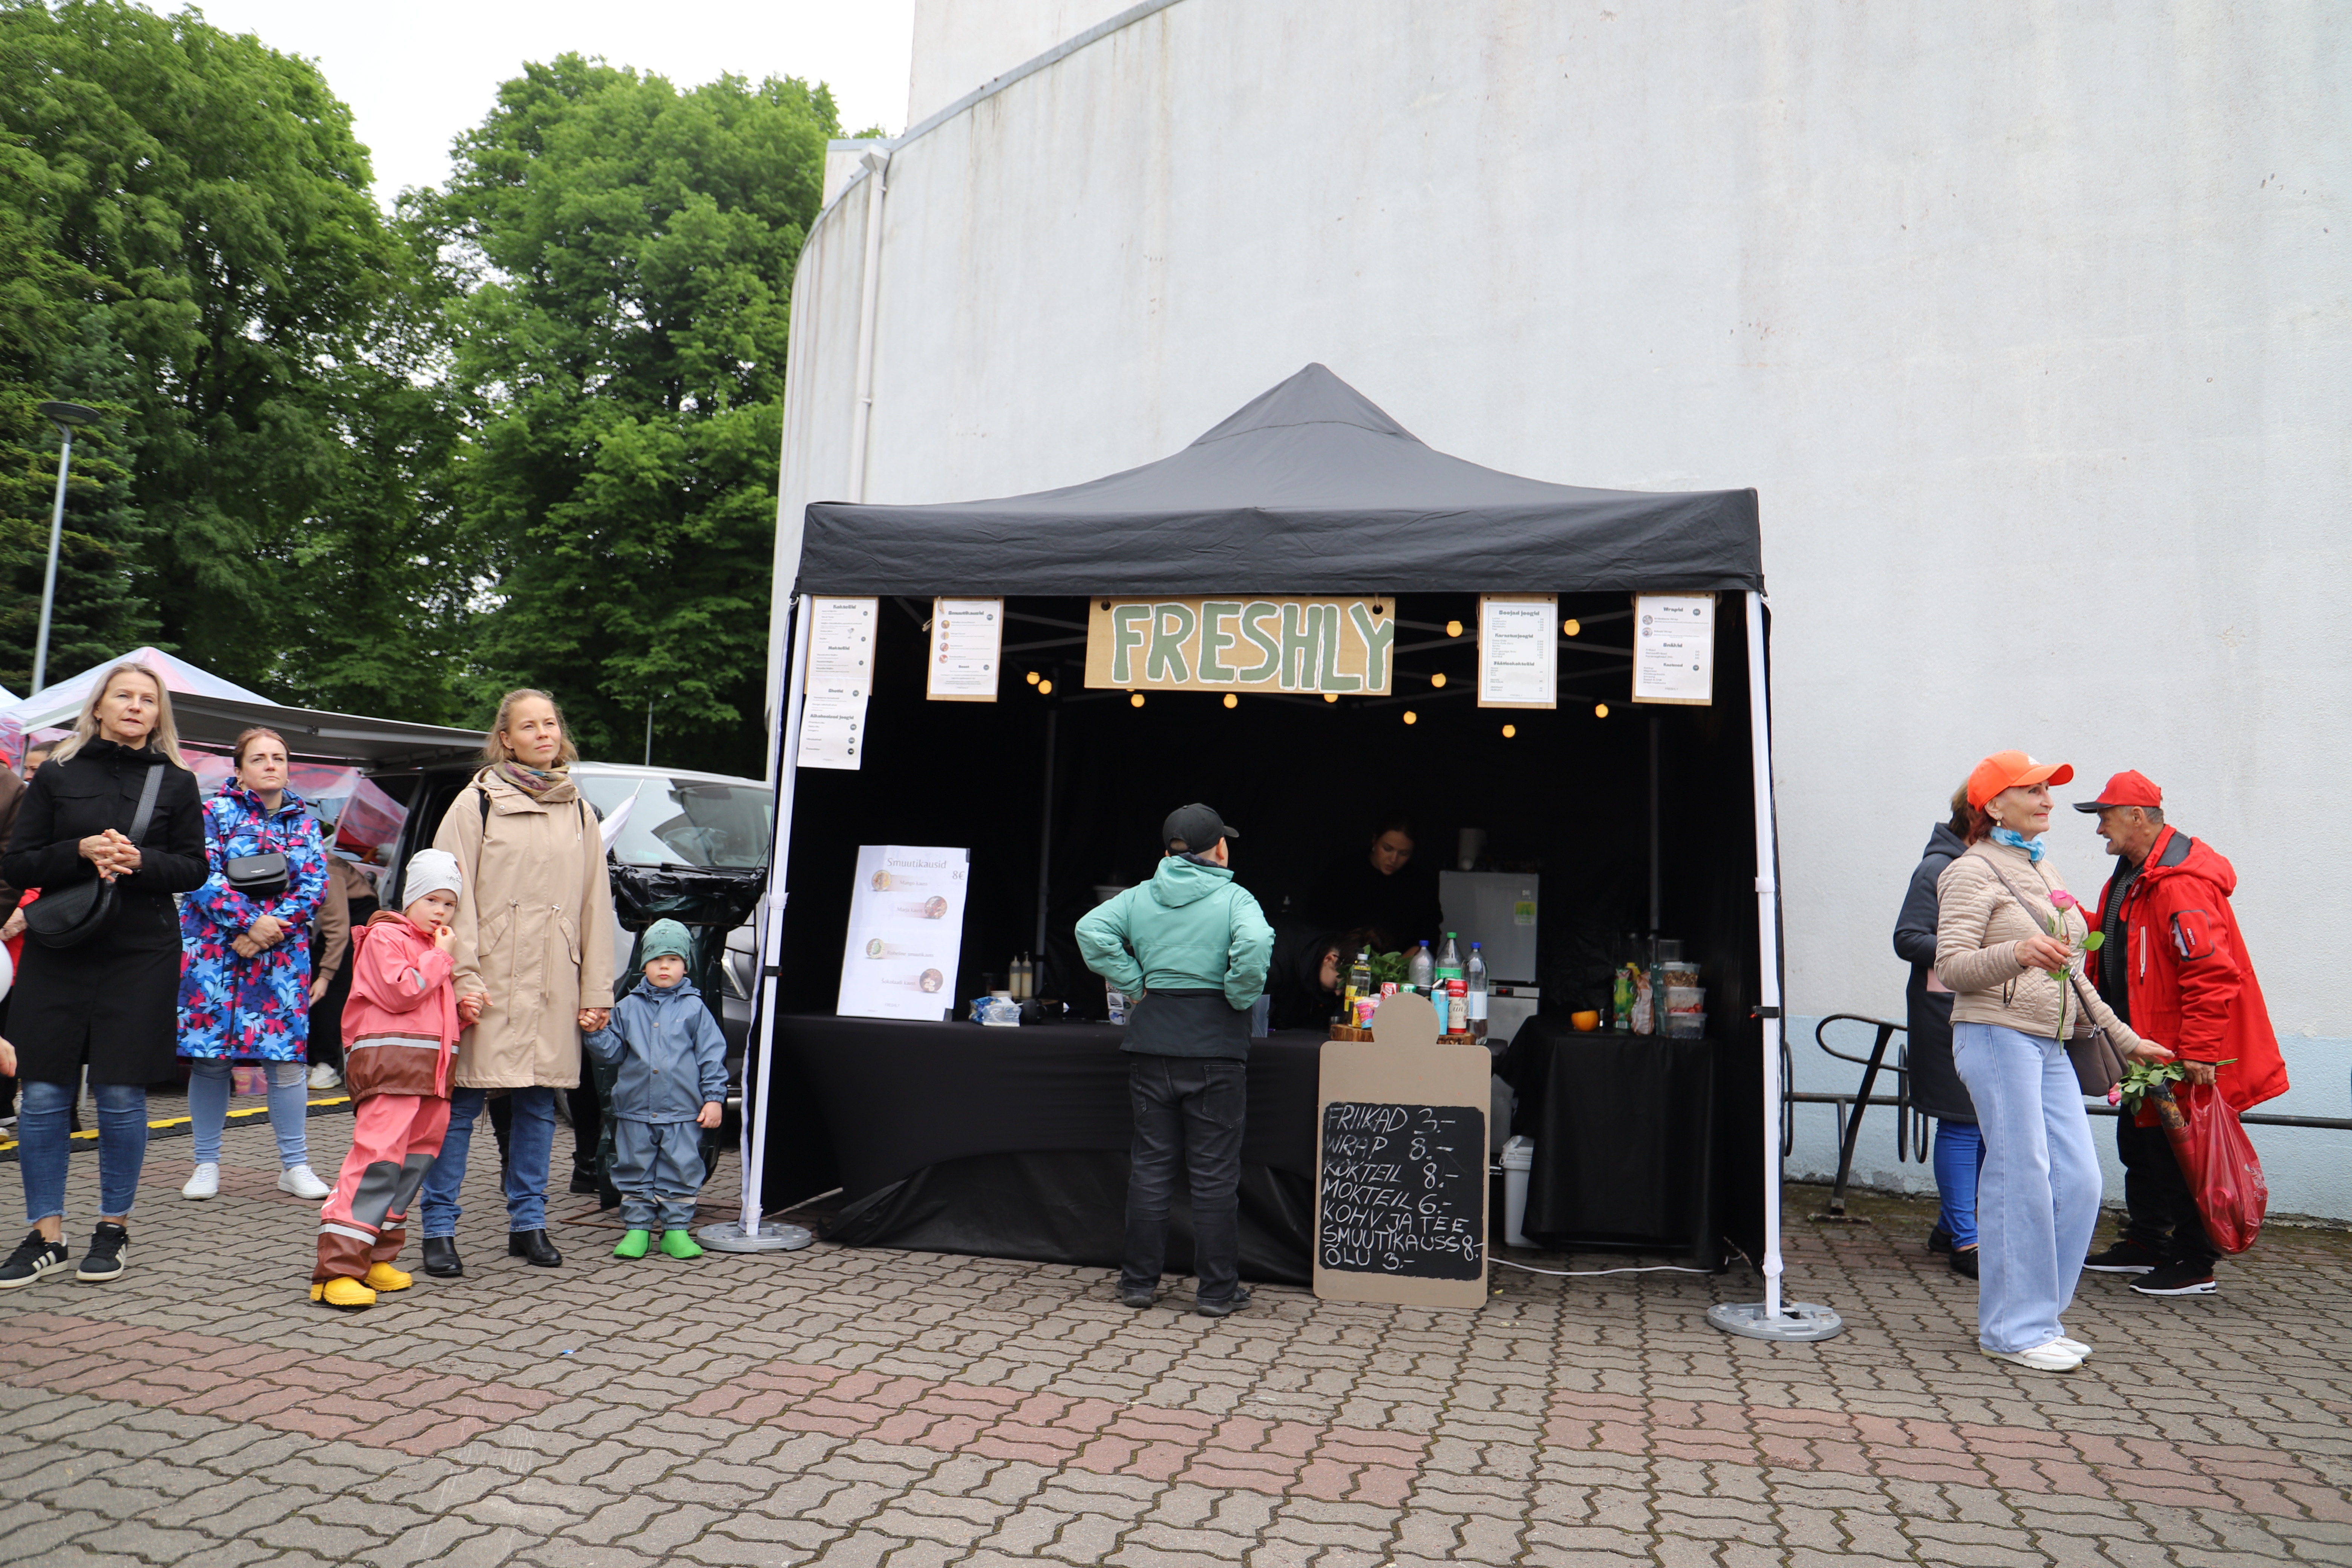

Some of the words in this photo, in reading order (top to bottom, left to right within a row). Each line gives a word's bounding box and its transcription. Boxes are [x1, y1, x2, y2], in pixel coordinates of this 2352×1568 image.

[1111, 601, 1393, 693] FRESHLY
[887, 858, 947, 869] Smuutikausid
[952, 871, 965, 881] 8€
[1328, 1105, 1408, 1133] FRIIKAD
[1326, 1134, 1388, 1160] WRAP
[1322, 1178, 1413, 1210] MOKTEIL
[1323, 1200, 1384, 1228] KOHV
[1385, 1213, 1412, 1234] JA
[1419, 1216, 1470, 1234] TEE
[1322, 1224, 1461, 1253] SMUUTIKAUSS
[1325, 1243, 1371, 1266] ÕLU
